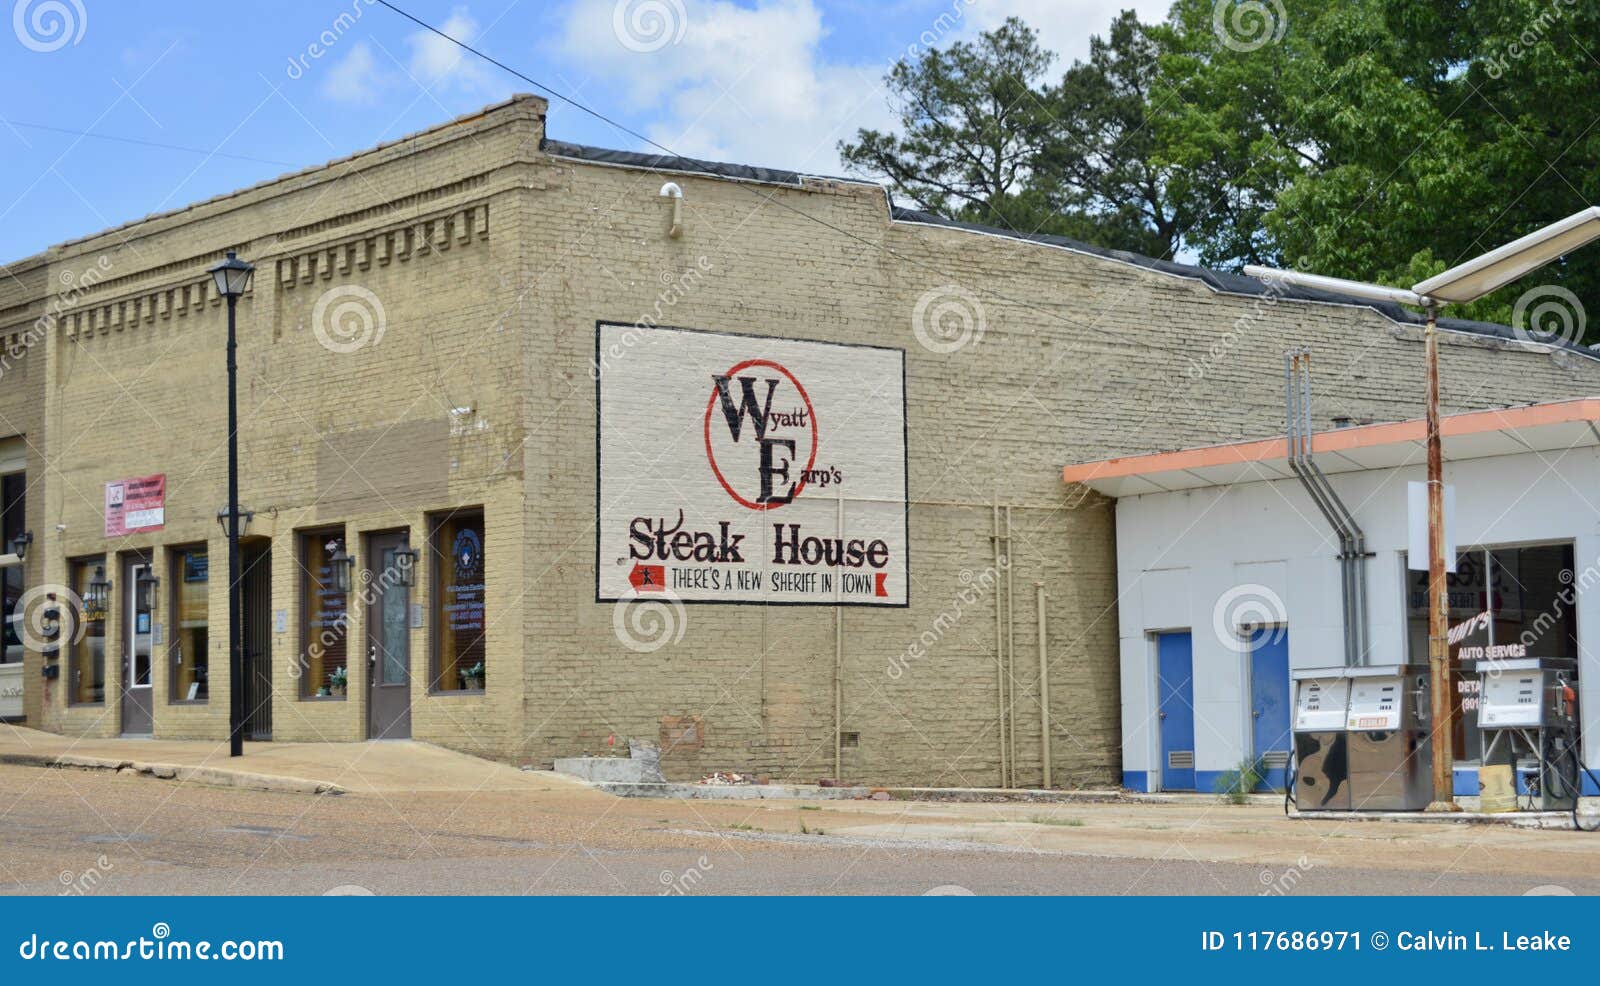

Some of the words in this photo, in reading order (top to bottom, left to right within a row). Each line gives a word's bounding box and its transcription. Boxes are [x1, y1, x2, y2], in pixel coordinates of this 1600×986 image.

[712, 374, 808, 442] Wyatt
[756, 438, 842, 504] Earp's
[629, 508, 745, 563] Steak
[772, 523, 889, 568] House
[672, 567, 720, 590] THERE'S
[724, 571, 733, 590] A
[737, 570, 763, 590] NEW
[772, 572, 817, 593] SHERIFF
[821, 573, 833, 592] IN
[842, 573, 872, 593] TOWN
[1458, 646, 1484, 660] AUTO
[1485, 643, 1526, 658] SERVICE
[1458, 680, 1481, 693] DETA
[1461, 697, 1480, 713] (901
